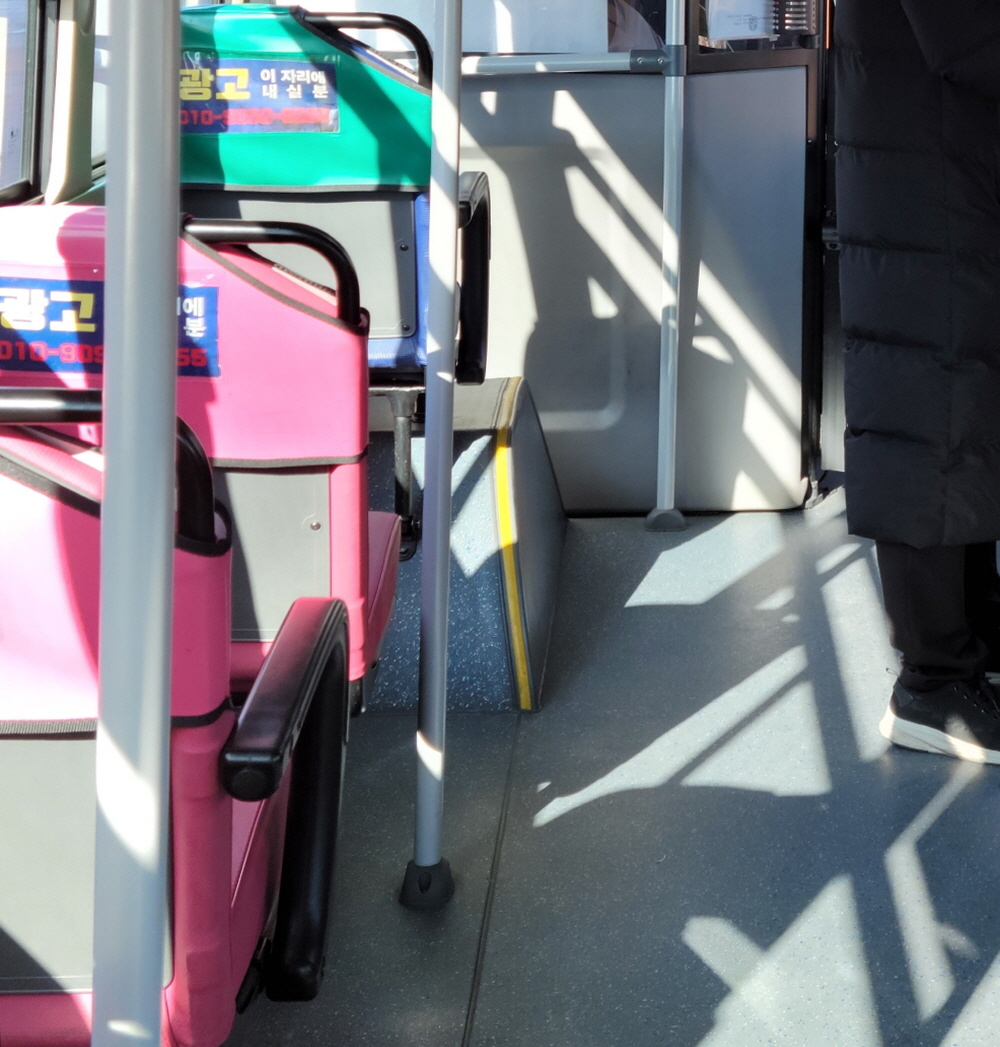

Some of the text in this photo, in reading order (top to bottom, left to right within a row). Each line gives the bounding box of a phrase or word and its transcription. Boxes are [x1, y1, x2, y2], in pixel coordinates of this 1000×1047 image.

[180, 68, 327, 101] 광고 이 자리에
[262, 83, 329, 100] 내 실 분
[0, 290, 96, 333] 광고
[183, 316, 207, 337] 분
